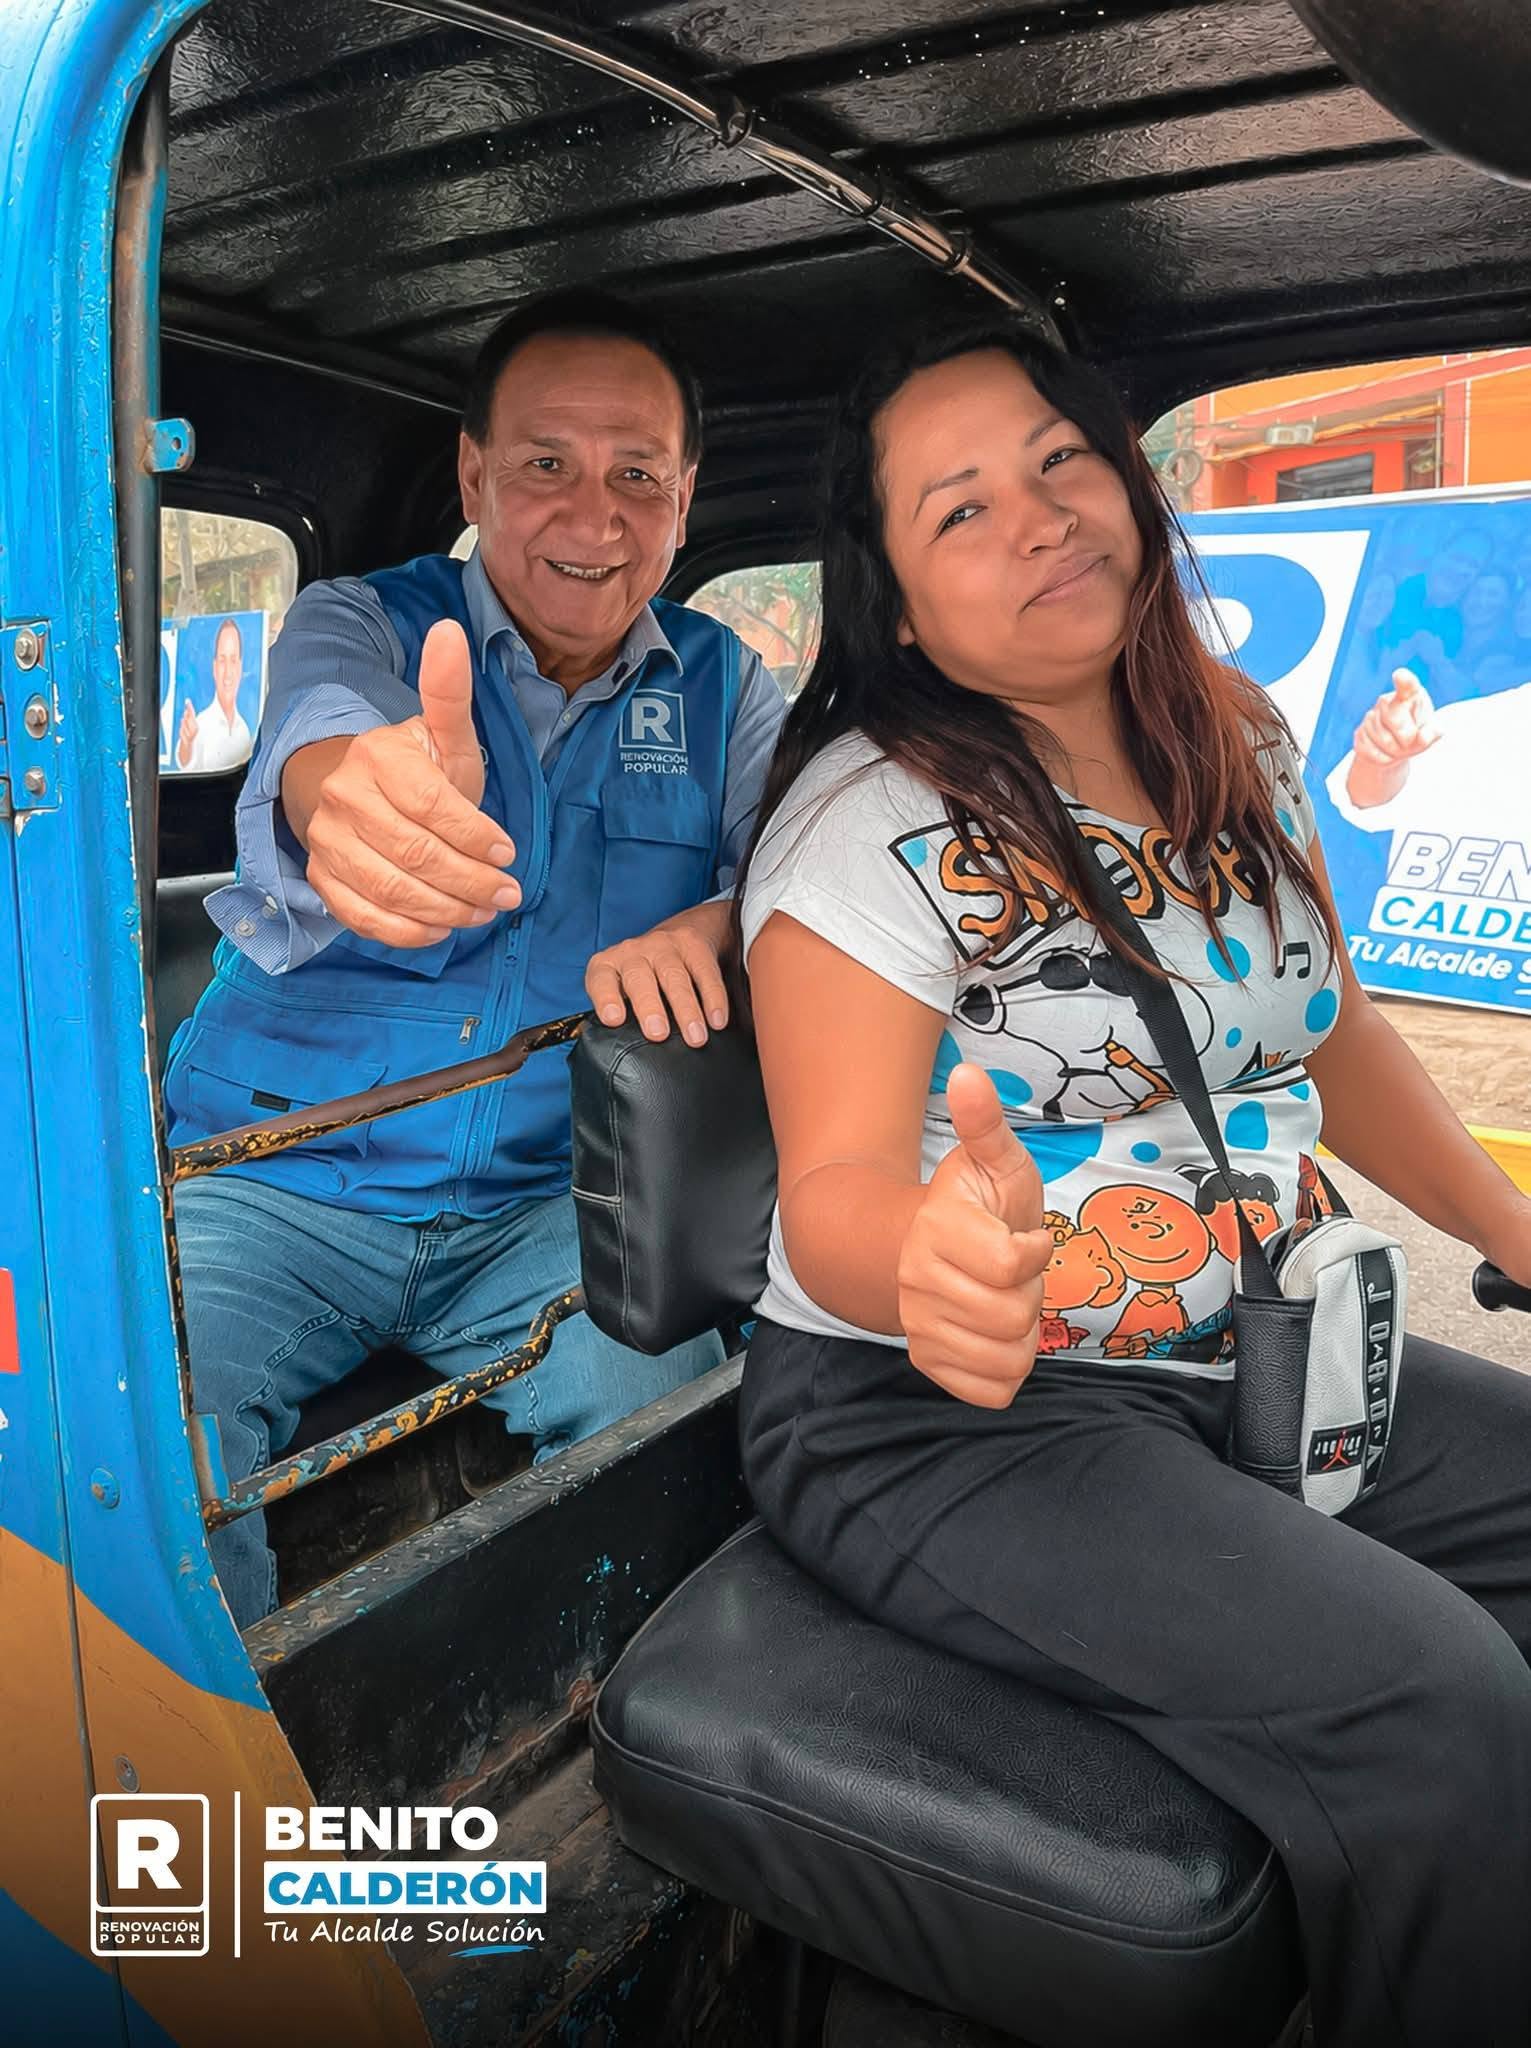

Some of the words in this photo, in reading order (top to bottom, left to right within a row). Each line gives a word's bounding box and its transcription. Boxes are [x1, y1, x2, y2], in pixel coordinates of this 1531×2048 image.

[632, 697, 674, 743] R
[624, 762, 688, 775] POPULAR
[1348, 935, 1386, 962] Tu
[1386, 942, 1512, 980] Alcalde
